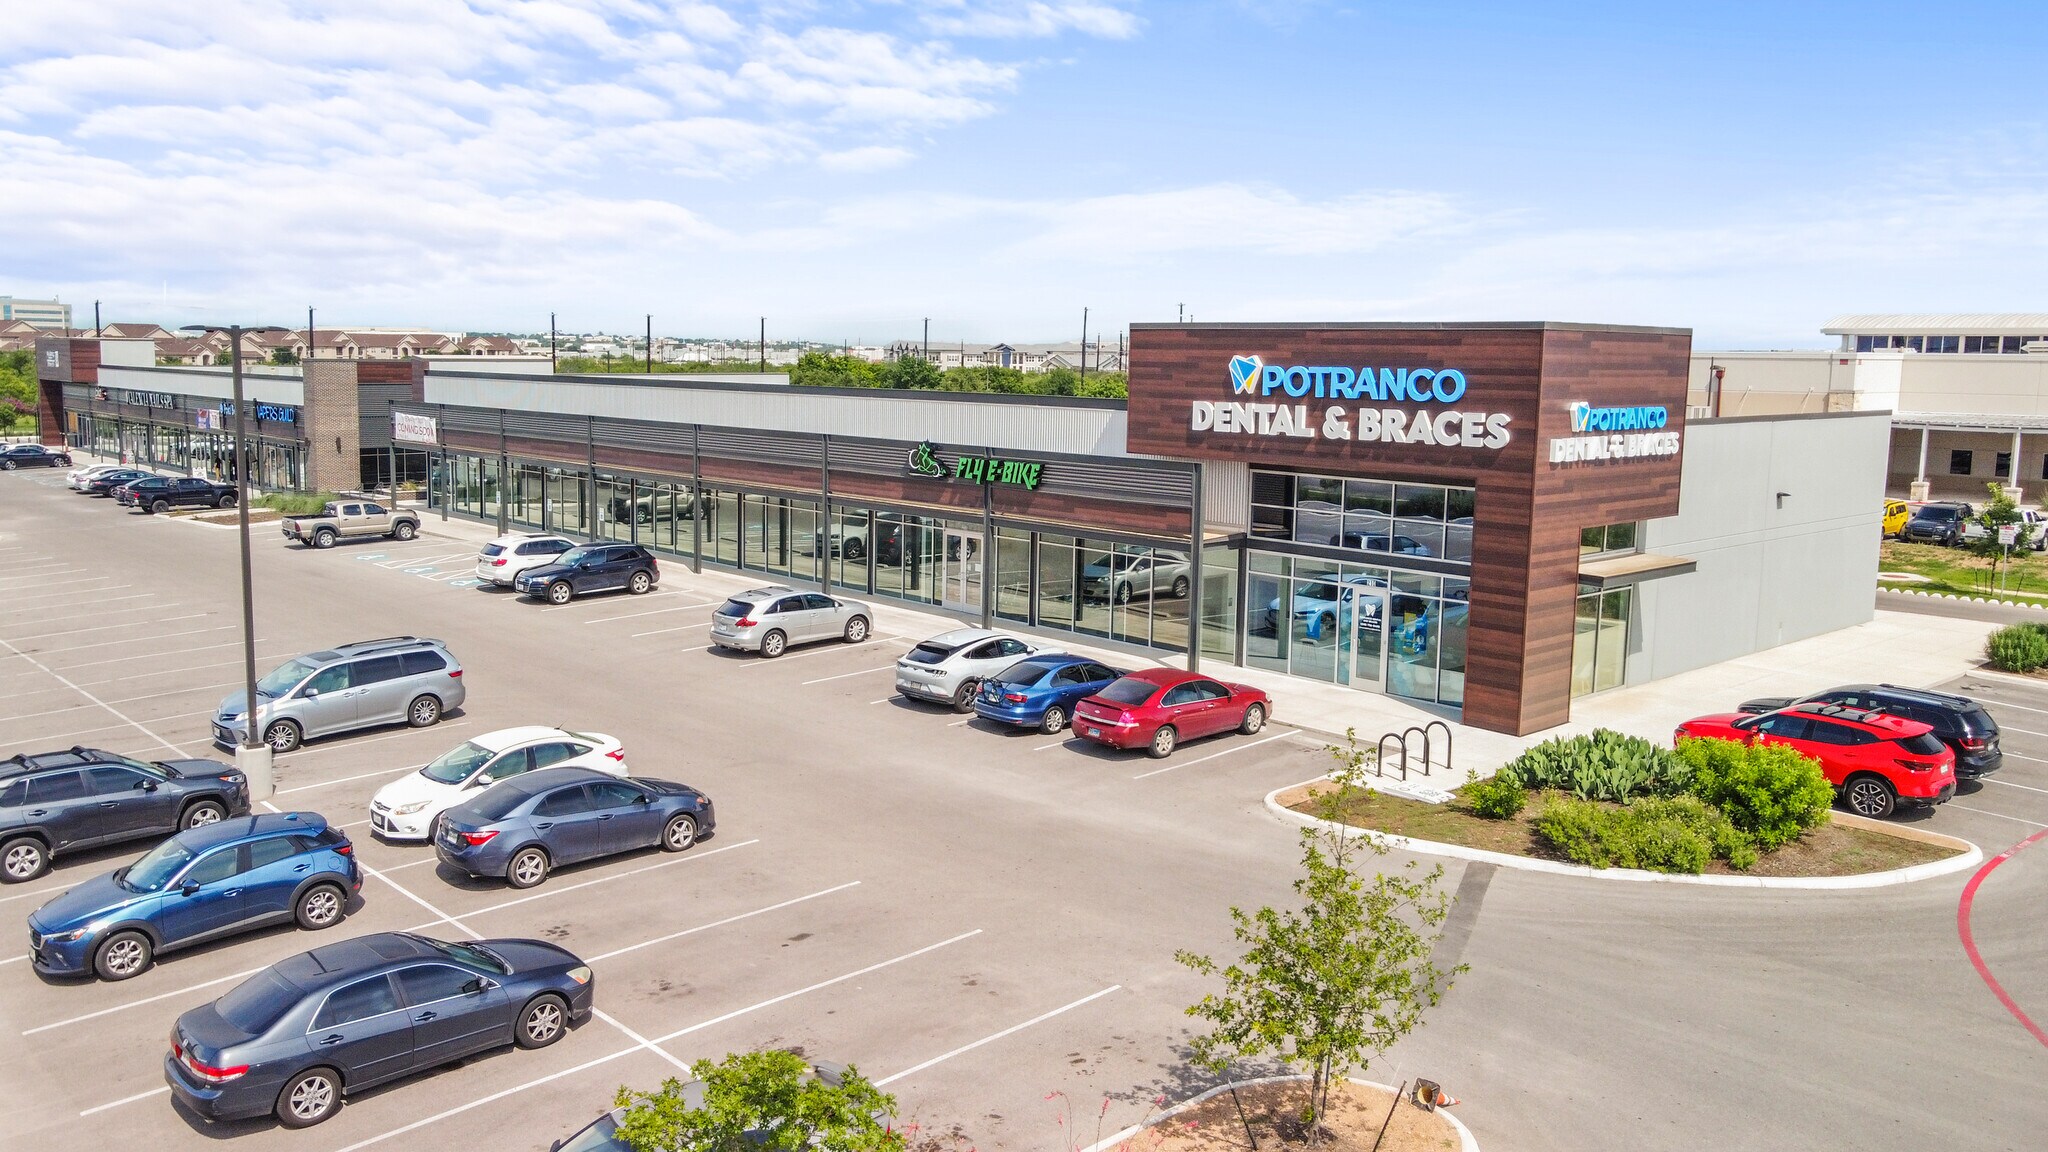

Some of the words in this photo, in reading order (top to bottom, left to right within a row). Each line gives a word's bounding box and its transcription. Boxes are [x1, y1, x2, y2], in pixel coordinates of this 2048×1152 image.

[1262, 365, 1466, 403] POTRANCO
[278, 407, 294, 422] GUILD
[398, 422, 418, 434] COMING
[419, 426, 434, 437] SOON
[1192, 401, 1314, 437] DENTAL
[1322, 406, 1350, 440] &
[1359, 407, 1511, 449] BRACES
[1587, 406, 1667, 431] POTRANCO
[1549, 436, 1610, 462] DENTAL
[1610, 434, 1624, 458] &
[1625, 432, 1679, 457] BRACES
[956, 457, 984, 484] FLY
[986, 460, 1040, 490] E-BIKE
